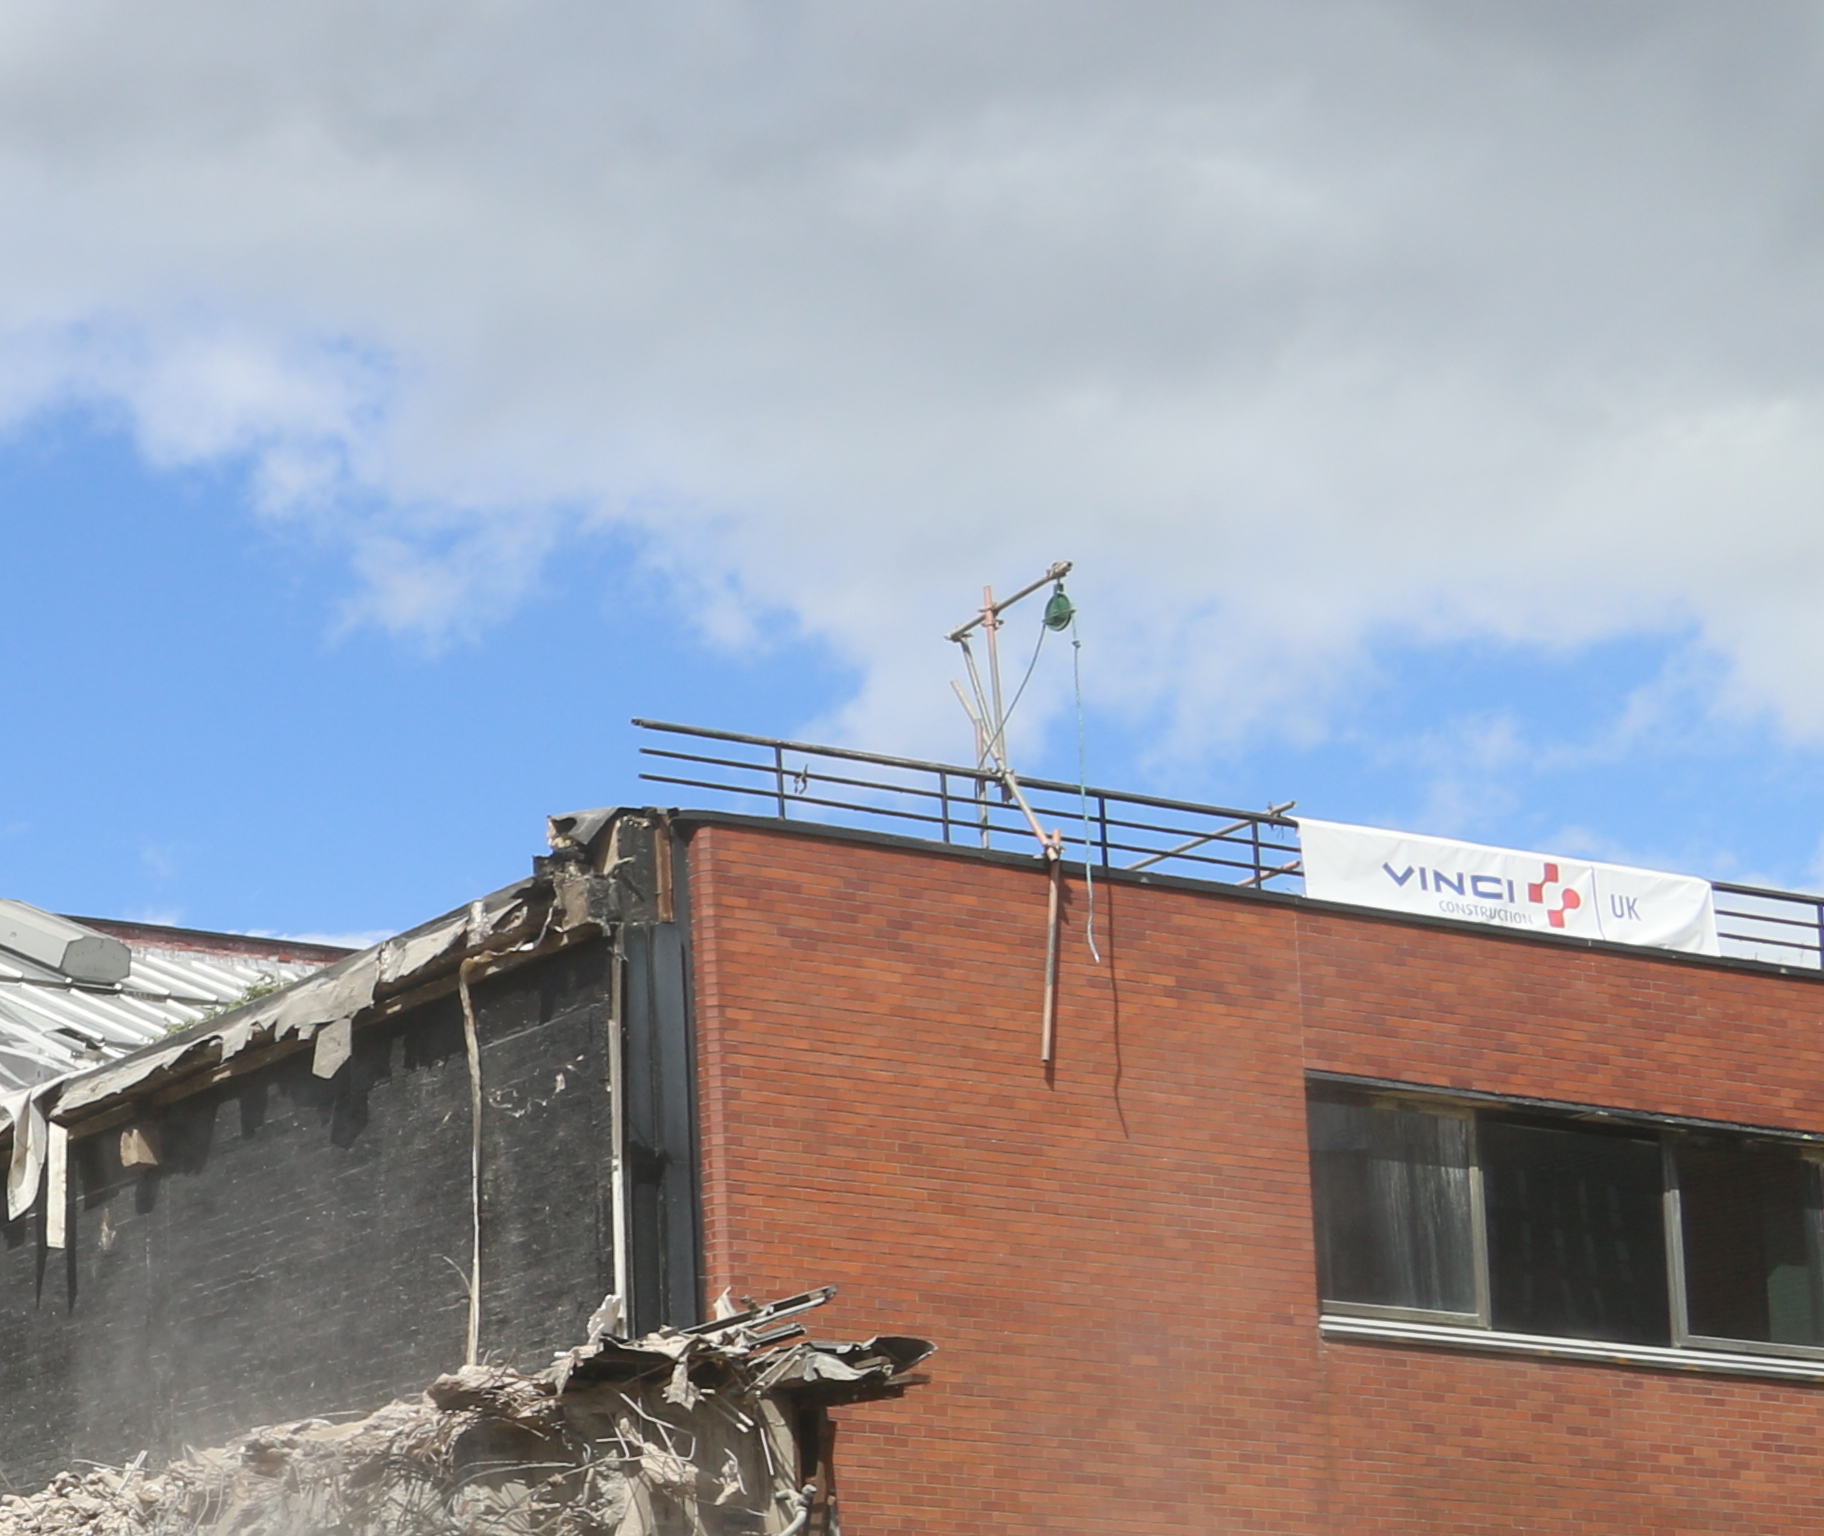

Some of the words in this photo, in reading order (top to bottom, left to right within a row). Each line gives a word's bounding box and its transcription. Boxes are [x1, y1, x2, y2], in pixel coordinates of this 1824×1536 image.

[1382, 861, 1515, 904] VINCI
[1439, 899, 1534, 925] CONSTRUCTION
[1610, 894, 1642, 921] UK
